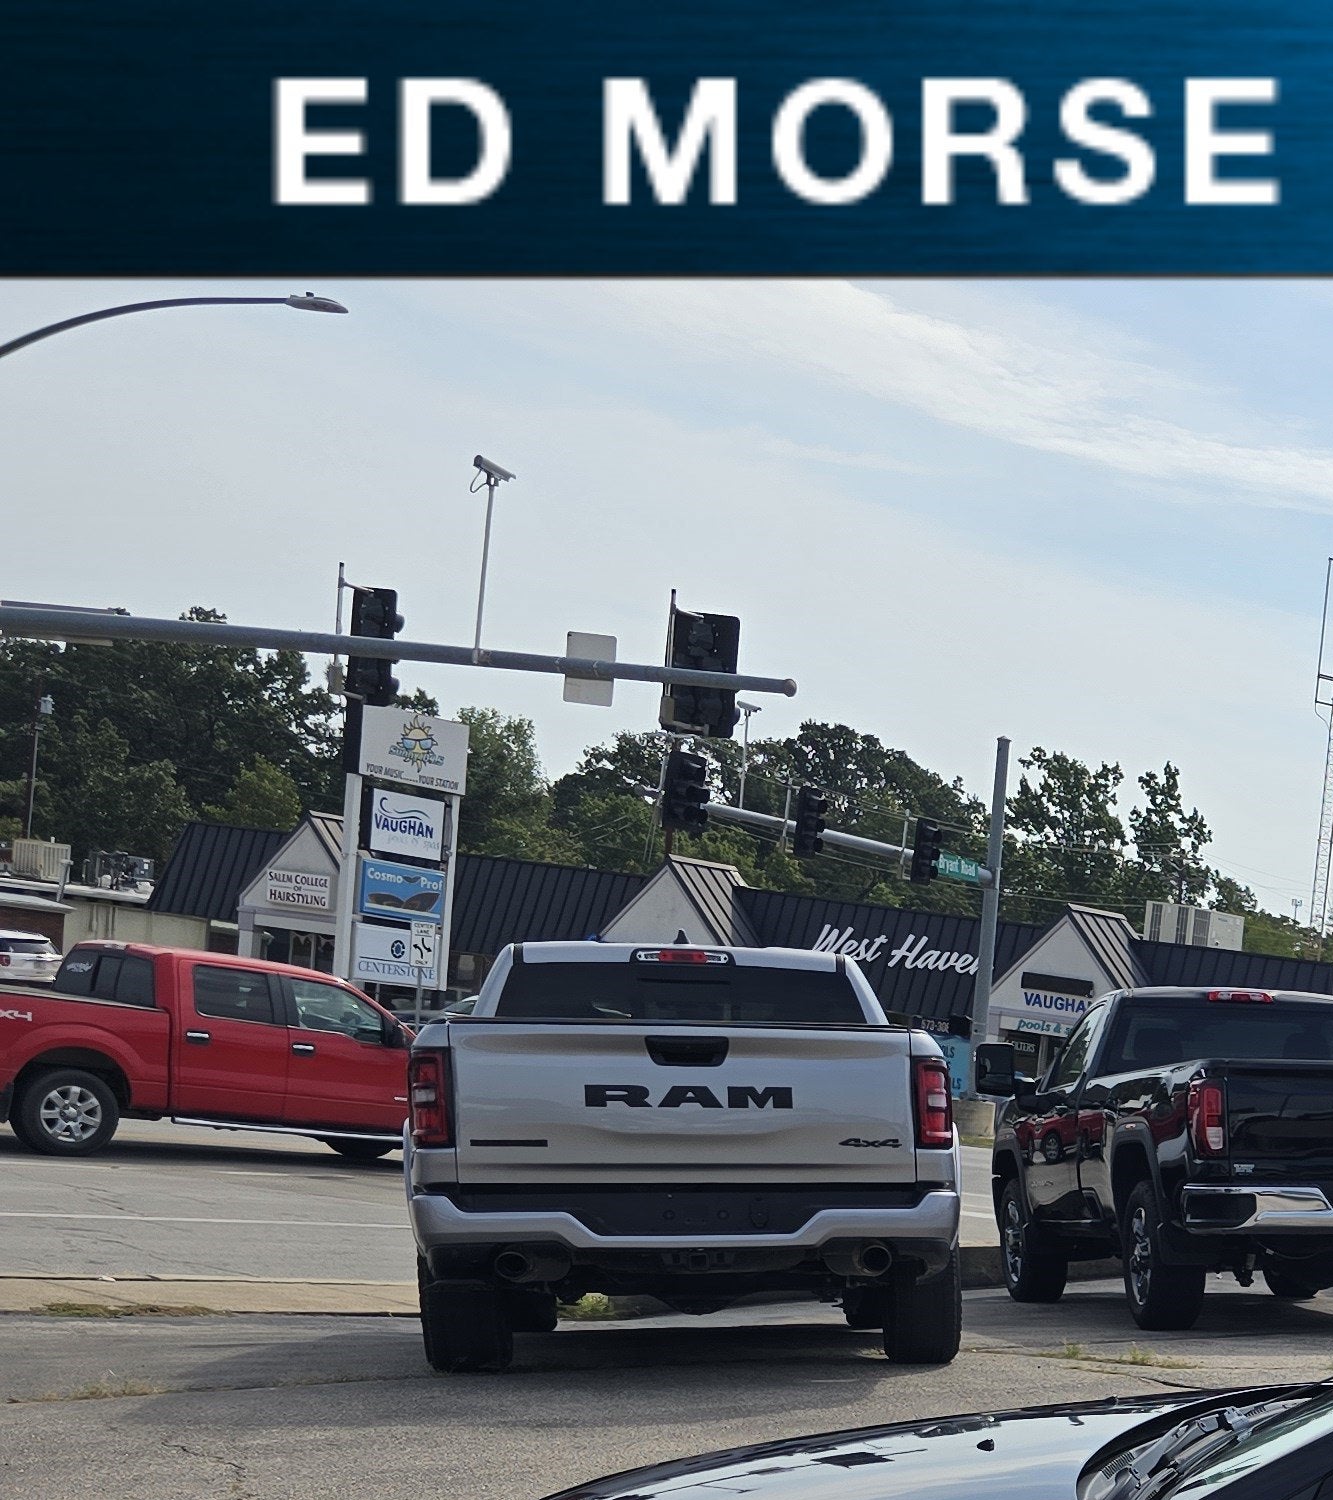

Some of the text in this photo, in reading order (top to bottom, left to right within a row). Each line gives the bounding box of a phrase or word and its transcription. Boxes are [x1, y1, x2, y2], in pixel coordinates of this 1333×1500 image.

[366, 763, 383, 776] YOUR
[435, 778, 460, 791] STATION
[374, 812, 434, 839] VAUGHAN
[268, 871, 328, 888] SALEM COLLEGE
[367, 867, 444, 891] Cosmo Prof
[269, 889, 326, 907] HAIRSTYLING
[812, 924, 888, 963] West
[1017, 1019, 1051, 1032] pools
[583, 1084, 794, 1109] RAM
[838, 1137, 902, 1149] 4x4
